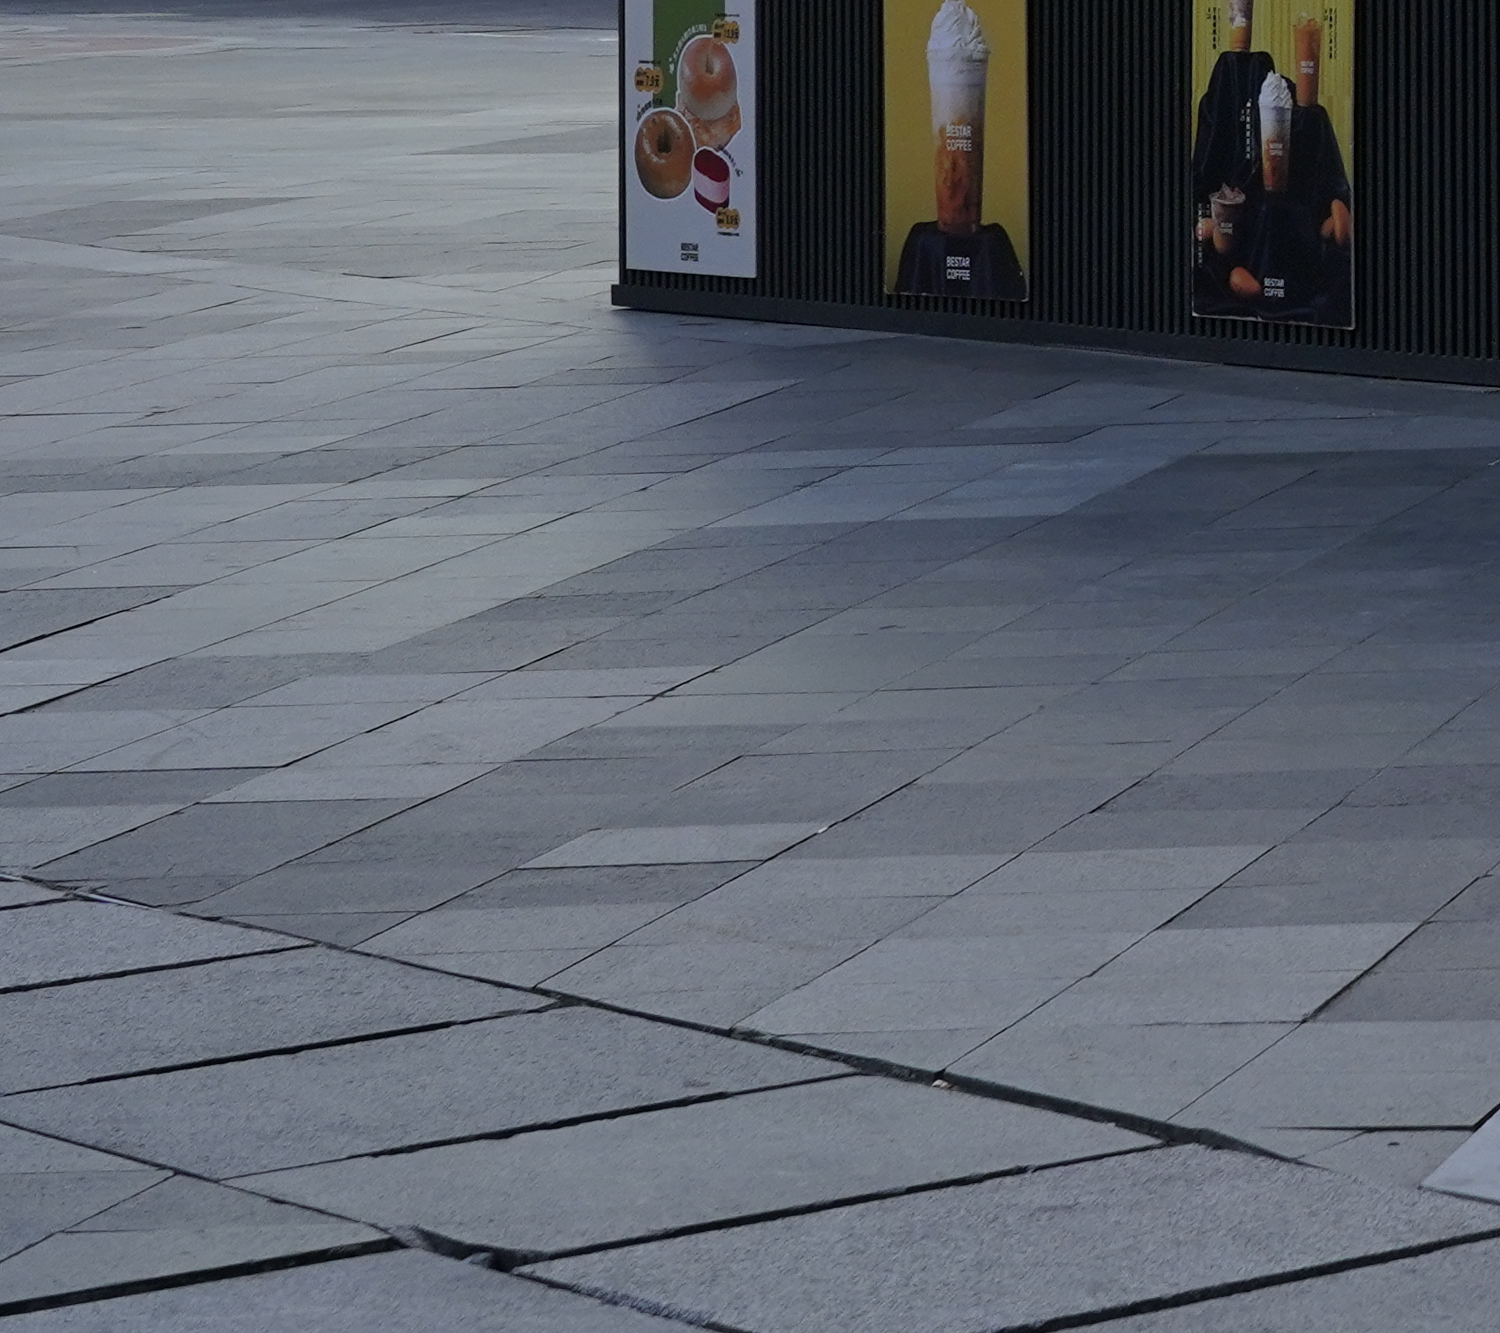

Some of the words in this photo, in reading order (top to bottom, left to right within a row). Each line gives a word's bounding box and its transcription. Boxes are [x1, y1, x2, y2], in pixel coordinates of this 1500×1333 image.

[946, 125, 972, 137] BESTAR
[946, 139, 972, 152] COFFEE
[946, 256, 970, 267] BESTAR
[946, 269, 971, 281] COFFEE
